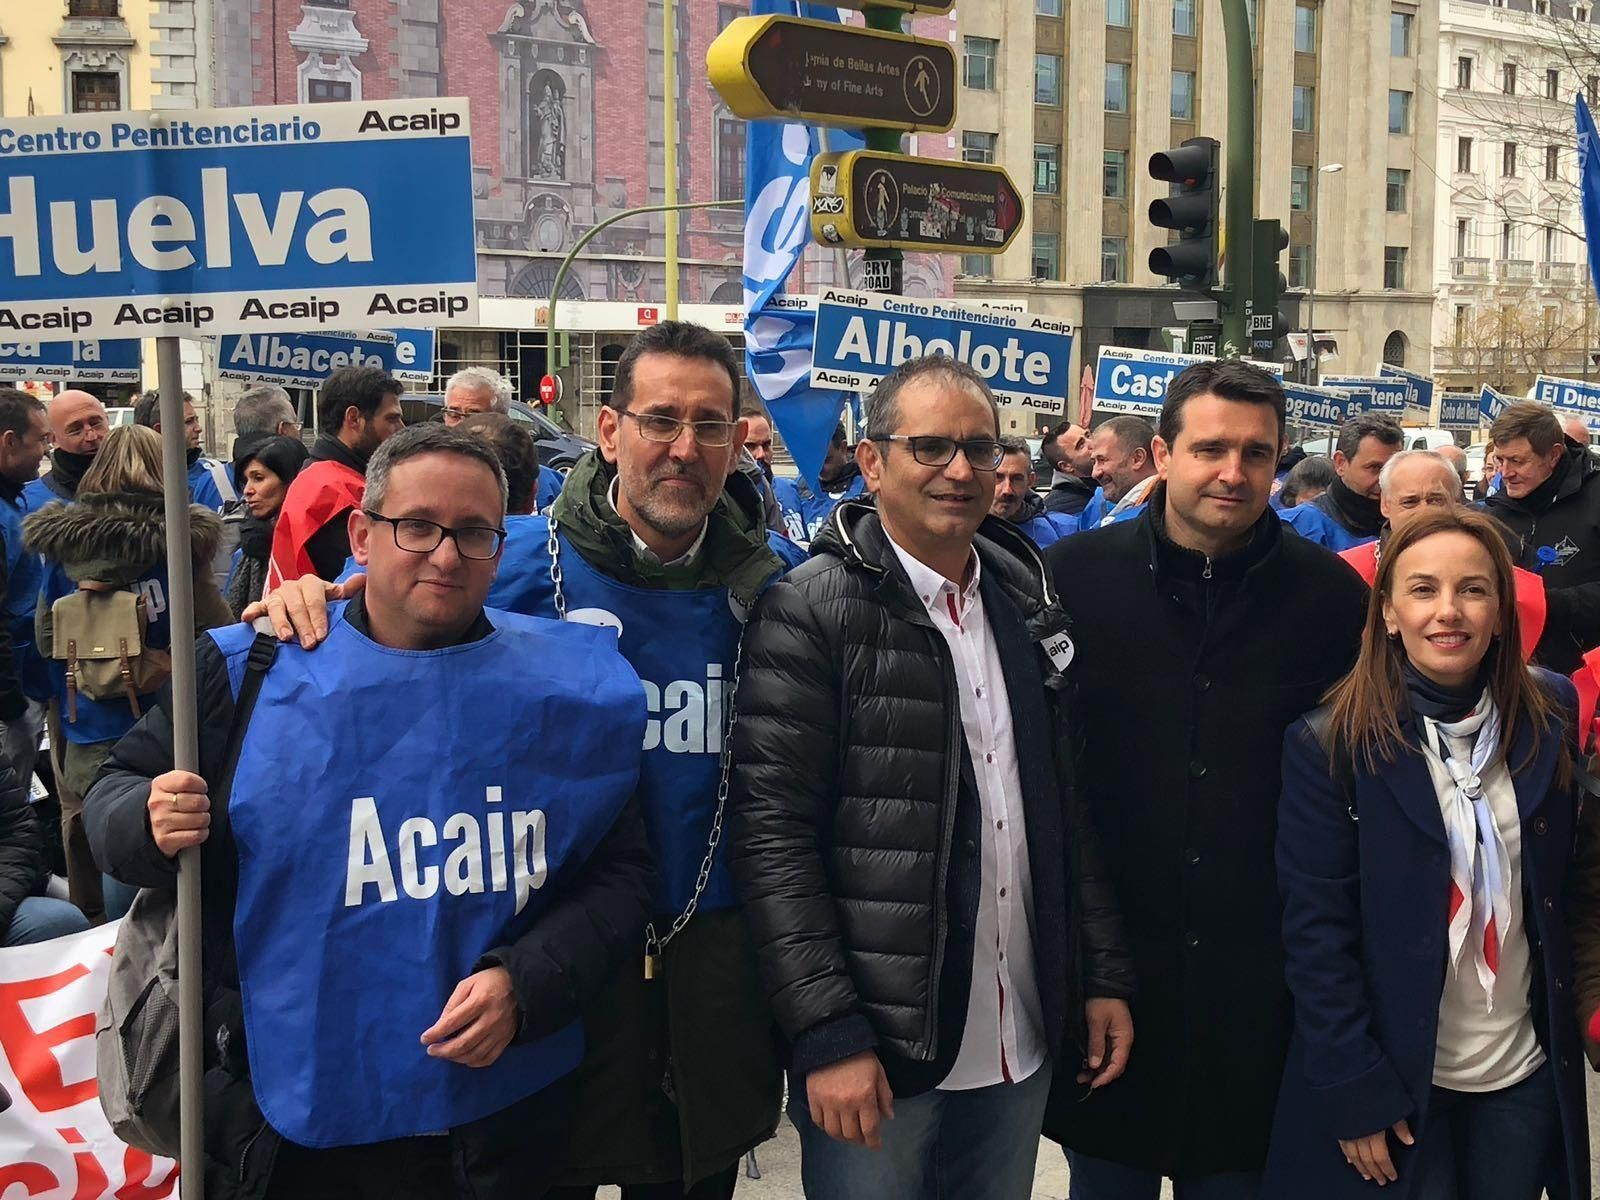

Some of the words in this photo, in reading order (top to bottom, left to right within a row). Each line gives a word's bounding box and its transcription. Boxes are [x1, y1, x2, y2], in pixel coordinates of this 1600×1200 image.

[847, 57, 874, 72] Bellas
[877, 62, 900, 76] Artes
[843, 81, 862, 94] Fine
[865, 84, 884, 97] Arts
[0, 126, 101, 153] Centro
[112, 116, 321, 148] Penitenciario
[358, 107, 461, 135] Acaip
[903, 183, 928, 196] Palacio
[0, 167, 374, 277] Huelva
[865, 261, 889, 275] CRY
[0, 306, 92, 333] Acaip
[114, 300, 214, 328] Acaip
[239, 296, 340, 323] Acaip
[367, 291, 469, 318] Acaip
[824, 291, 868, 307] Acaip
[883, 299, 929, 315] Centro
[932, 305, 1016, 327] Penitenciario
[1031, 318, 1071, 334] Acaip
[1253, 316, 1272, 328] BNE
[366, 332, 394, 342] Acaip
[1103, 349, 1133, 359] Acaip
[1143, 353, 1175, 364] Centro
[1195, 343, 1214, 355] BNE
[0, 365, 26, 376] caip
[36, 366, 71, 376] Acaip
[77, 370, 104, 379] Acaip
[111, 370, 138, 379] Acaip
[400, 371, 429, 381] Acaip
[220, 371, 251, 381] Acaip
[256, 374, 286, 385] Acaip
[291, 377, 320, 388] Acaip
[816, 371, 860, 387] Acaip
[1021, 396, 1061, 412] Acaip
[1542, 384, 1559, 402] El
[1097, 401, 1127, 412] Acaip
[1132, 404, 1162, 415] Acaip
[640, 663, 737, 768] cai
[344, 786, 548, 915] Acaip
